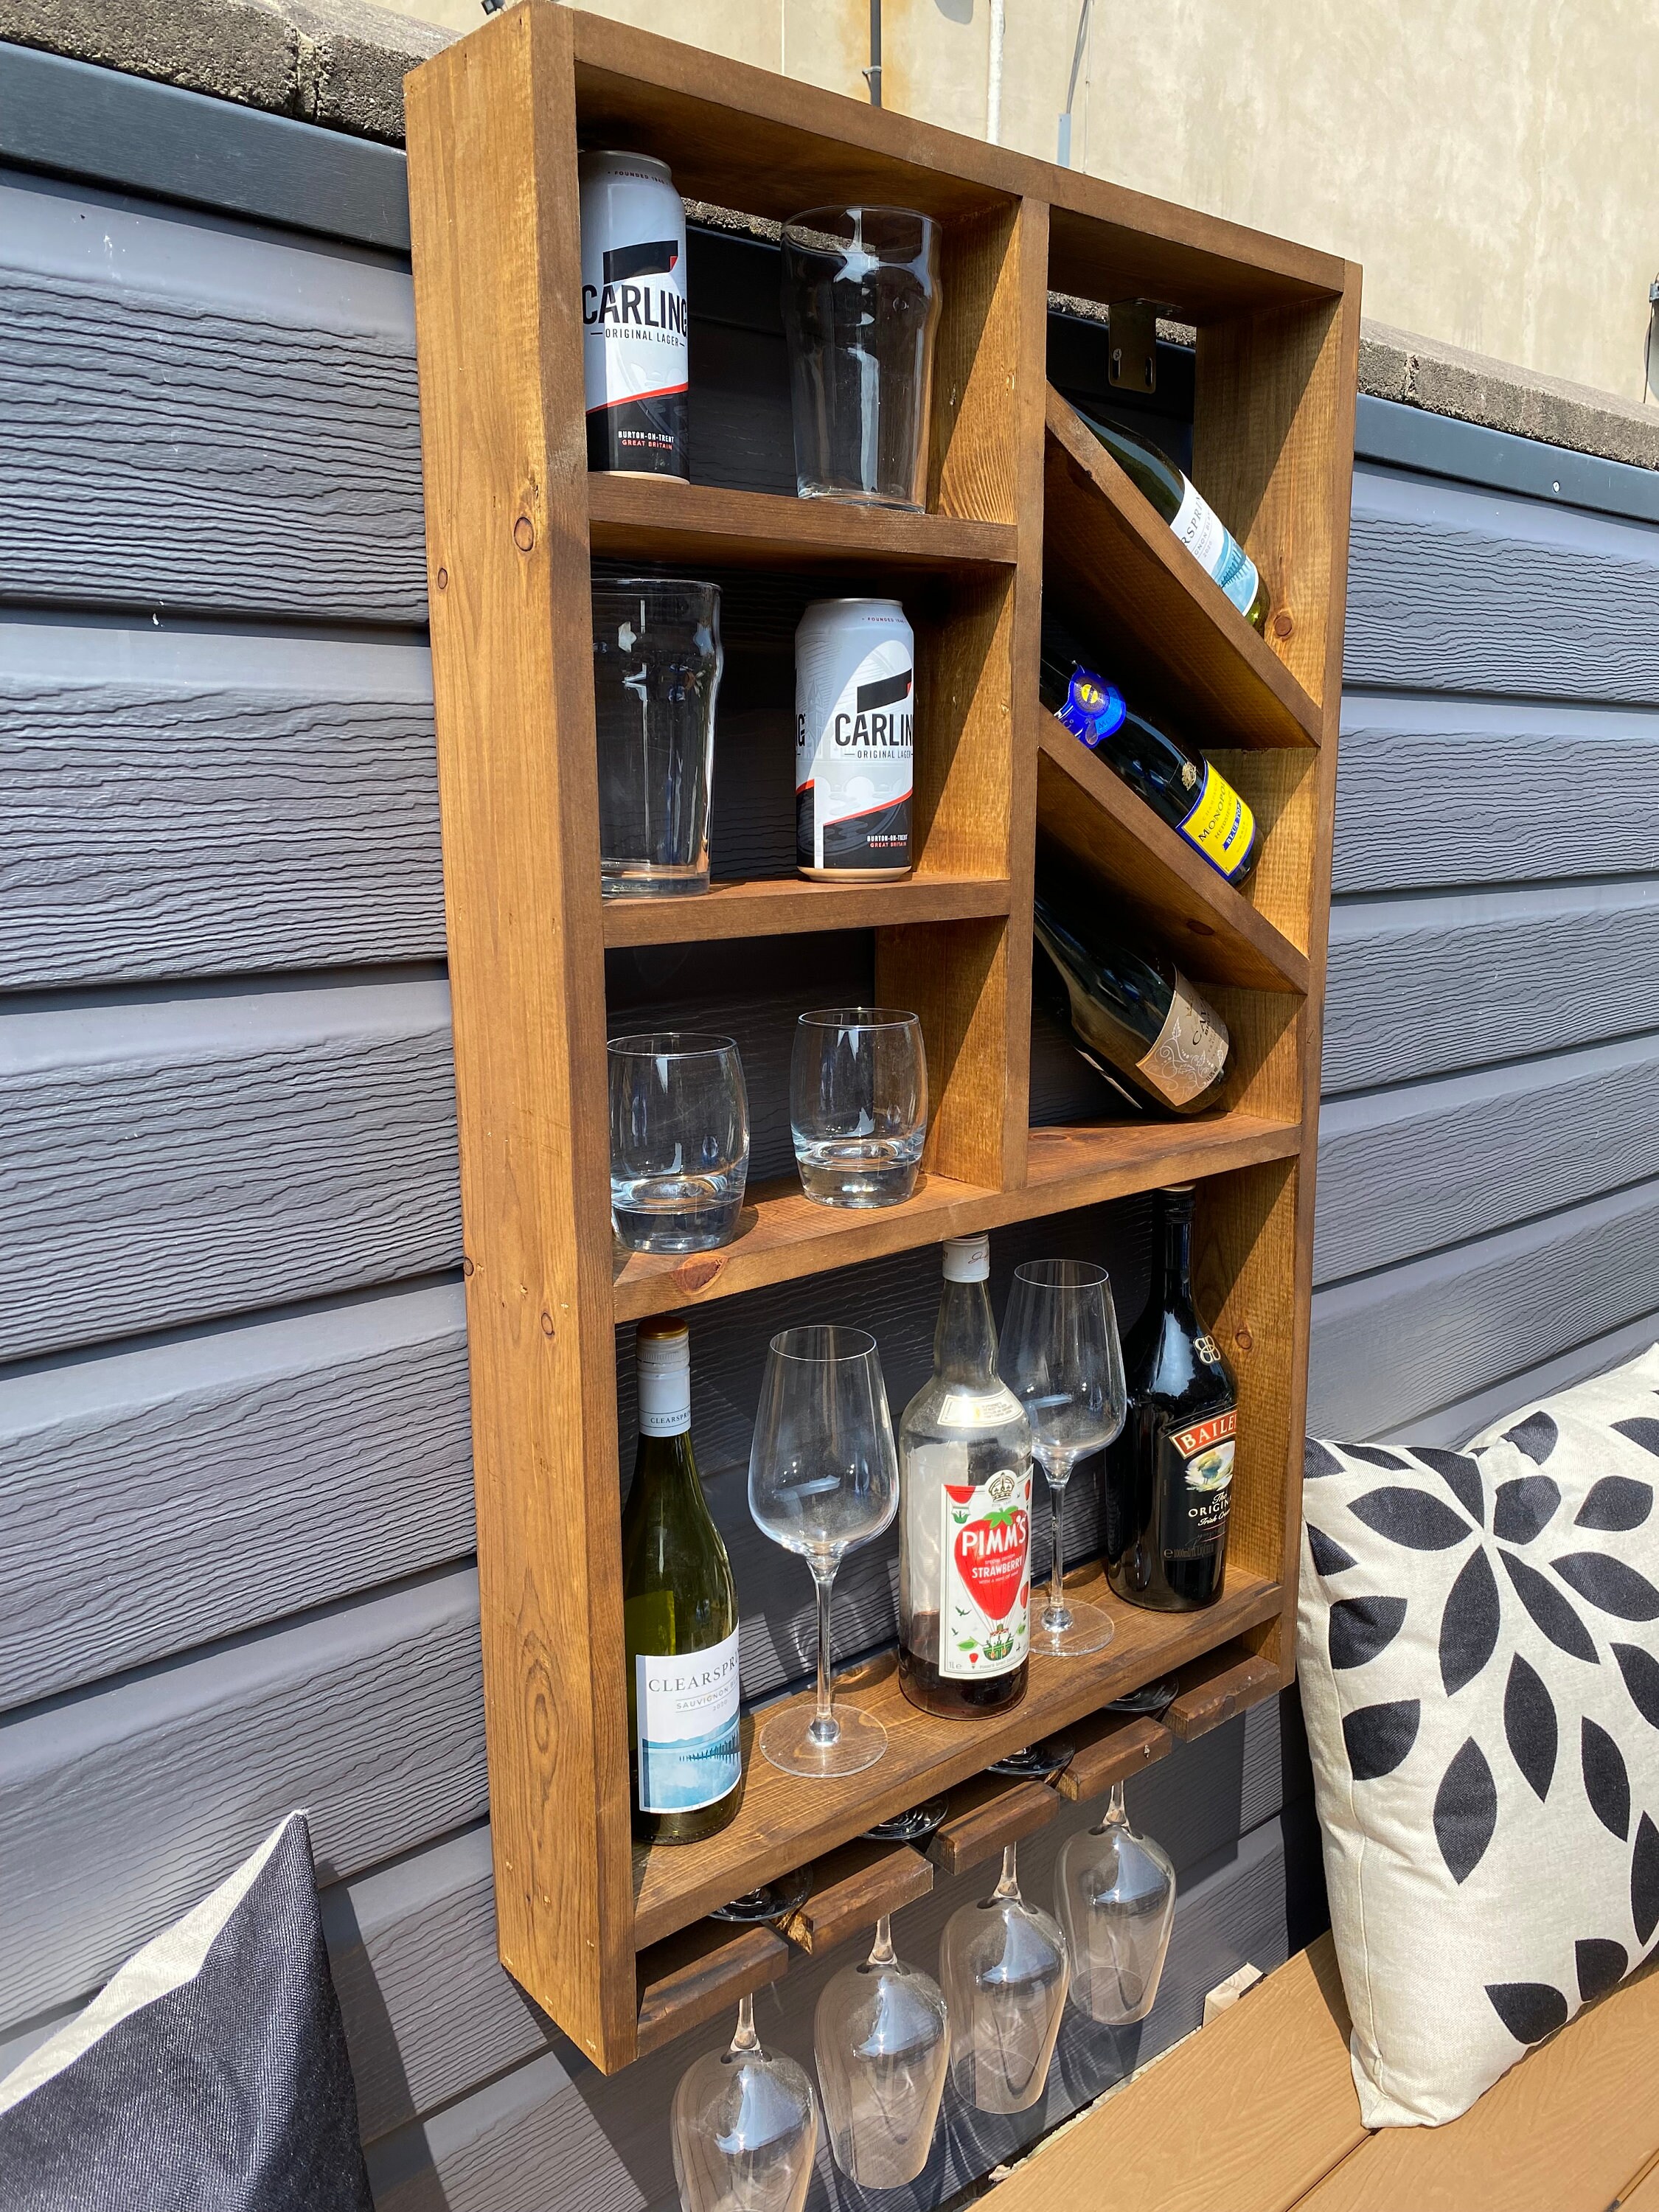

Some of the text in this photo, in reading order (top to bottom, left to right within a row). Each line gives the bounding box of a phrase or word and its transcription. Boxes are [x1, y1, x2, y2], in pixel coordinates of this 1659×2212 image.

[614, 170, 649, 179] FOUNDED
[605, 328, 679, 347] ORIGINAL LAGER
[618, 431, 675, 443] BURTON-ON-TRENT
[648, 442, 672, 451] BRITAIN
[858, 750, 895, 759] ORIGINAL
[1226, 821, 1239, 845] BLUE
[1211, 1491, 1227, 1504] The
[1197, 1514, 1217, 1526] Irish
[962, 1513, 1028, 1557] PIMM'S
[972, 1555, 1023, 1579] STRAWBERRY
[649, 1648, 738, 1693] CLEARSPRI
[676, 1688, 728, 1710] SAUVIGNON
